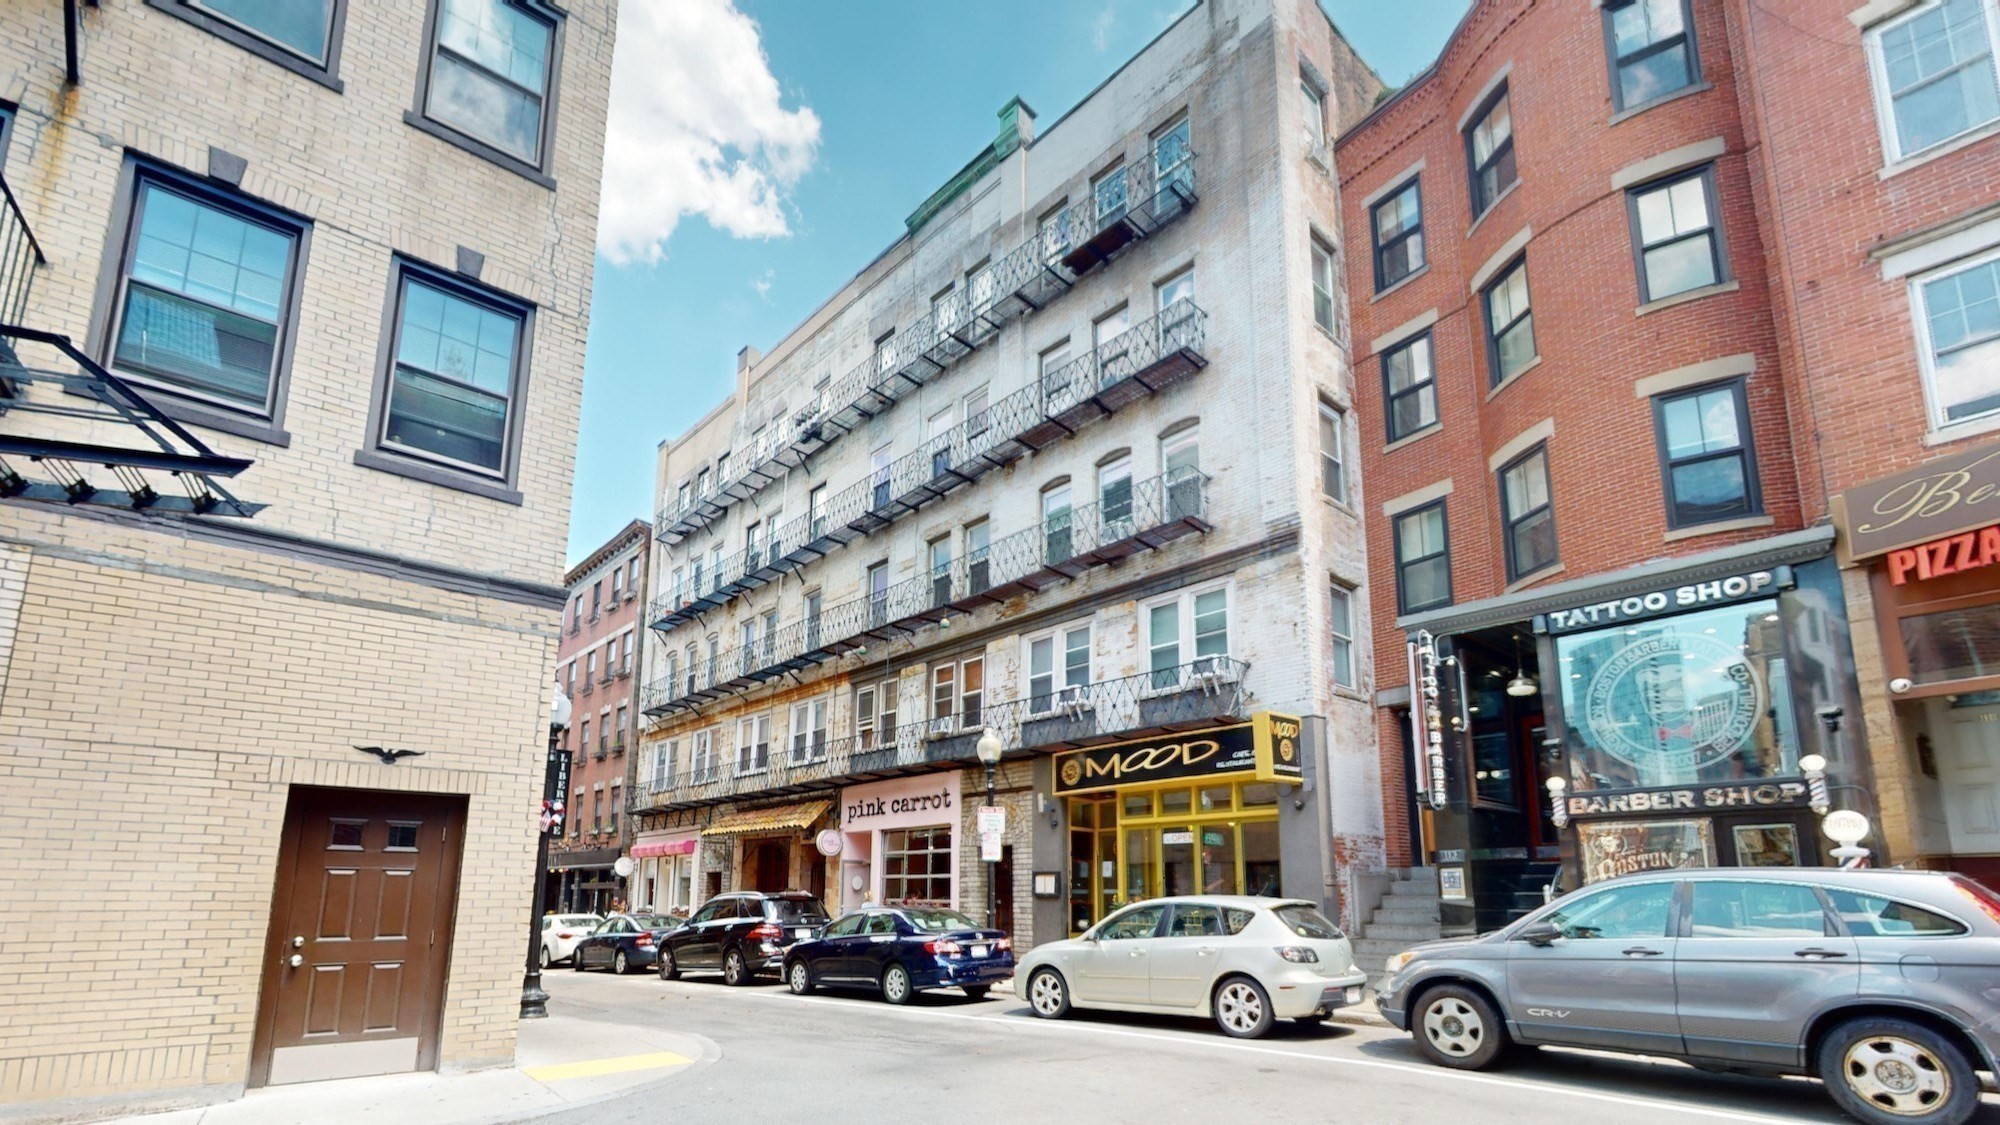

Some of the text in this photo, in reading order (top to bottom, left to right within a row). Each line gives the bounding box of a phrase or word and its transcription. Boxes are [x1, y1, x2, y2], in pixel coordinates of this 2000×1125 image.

[1857, 450, 2000, 534] Be
[1887, 526, 2000, 586] PIZZA
[1550, 571, 1772, 629] TATTOO SHOP
[1594, 658, 1628, 700] BOSTON
[1270, 720, 1299, 739] MOOD
[1085, 740, 1219, 779] MOOD
[1429, 731, 1445, 805] BARBER
[552, 753, 568, 835] LIBERE
[847, 787, 952, 823] pink carrot
[1568, 783, 1806, 815] BARBER SHOP
[1526, 1008, 1571, 1018] CR-V
